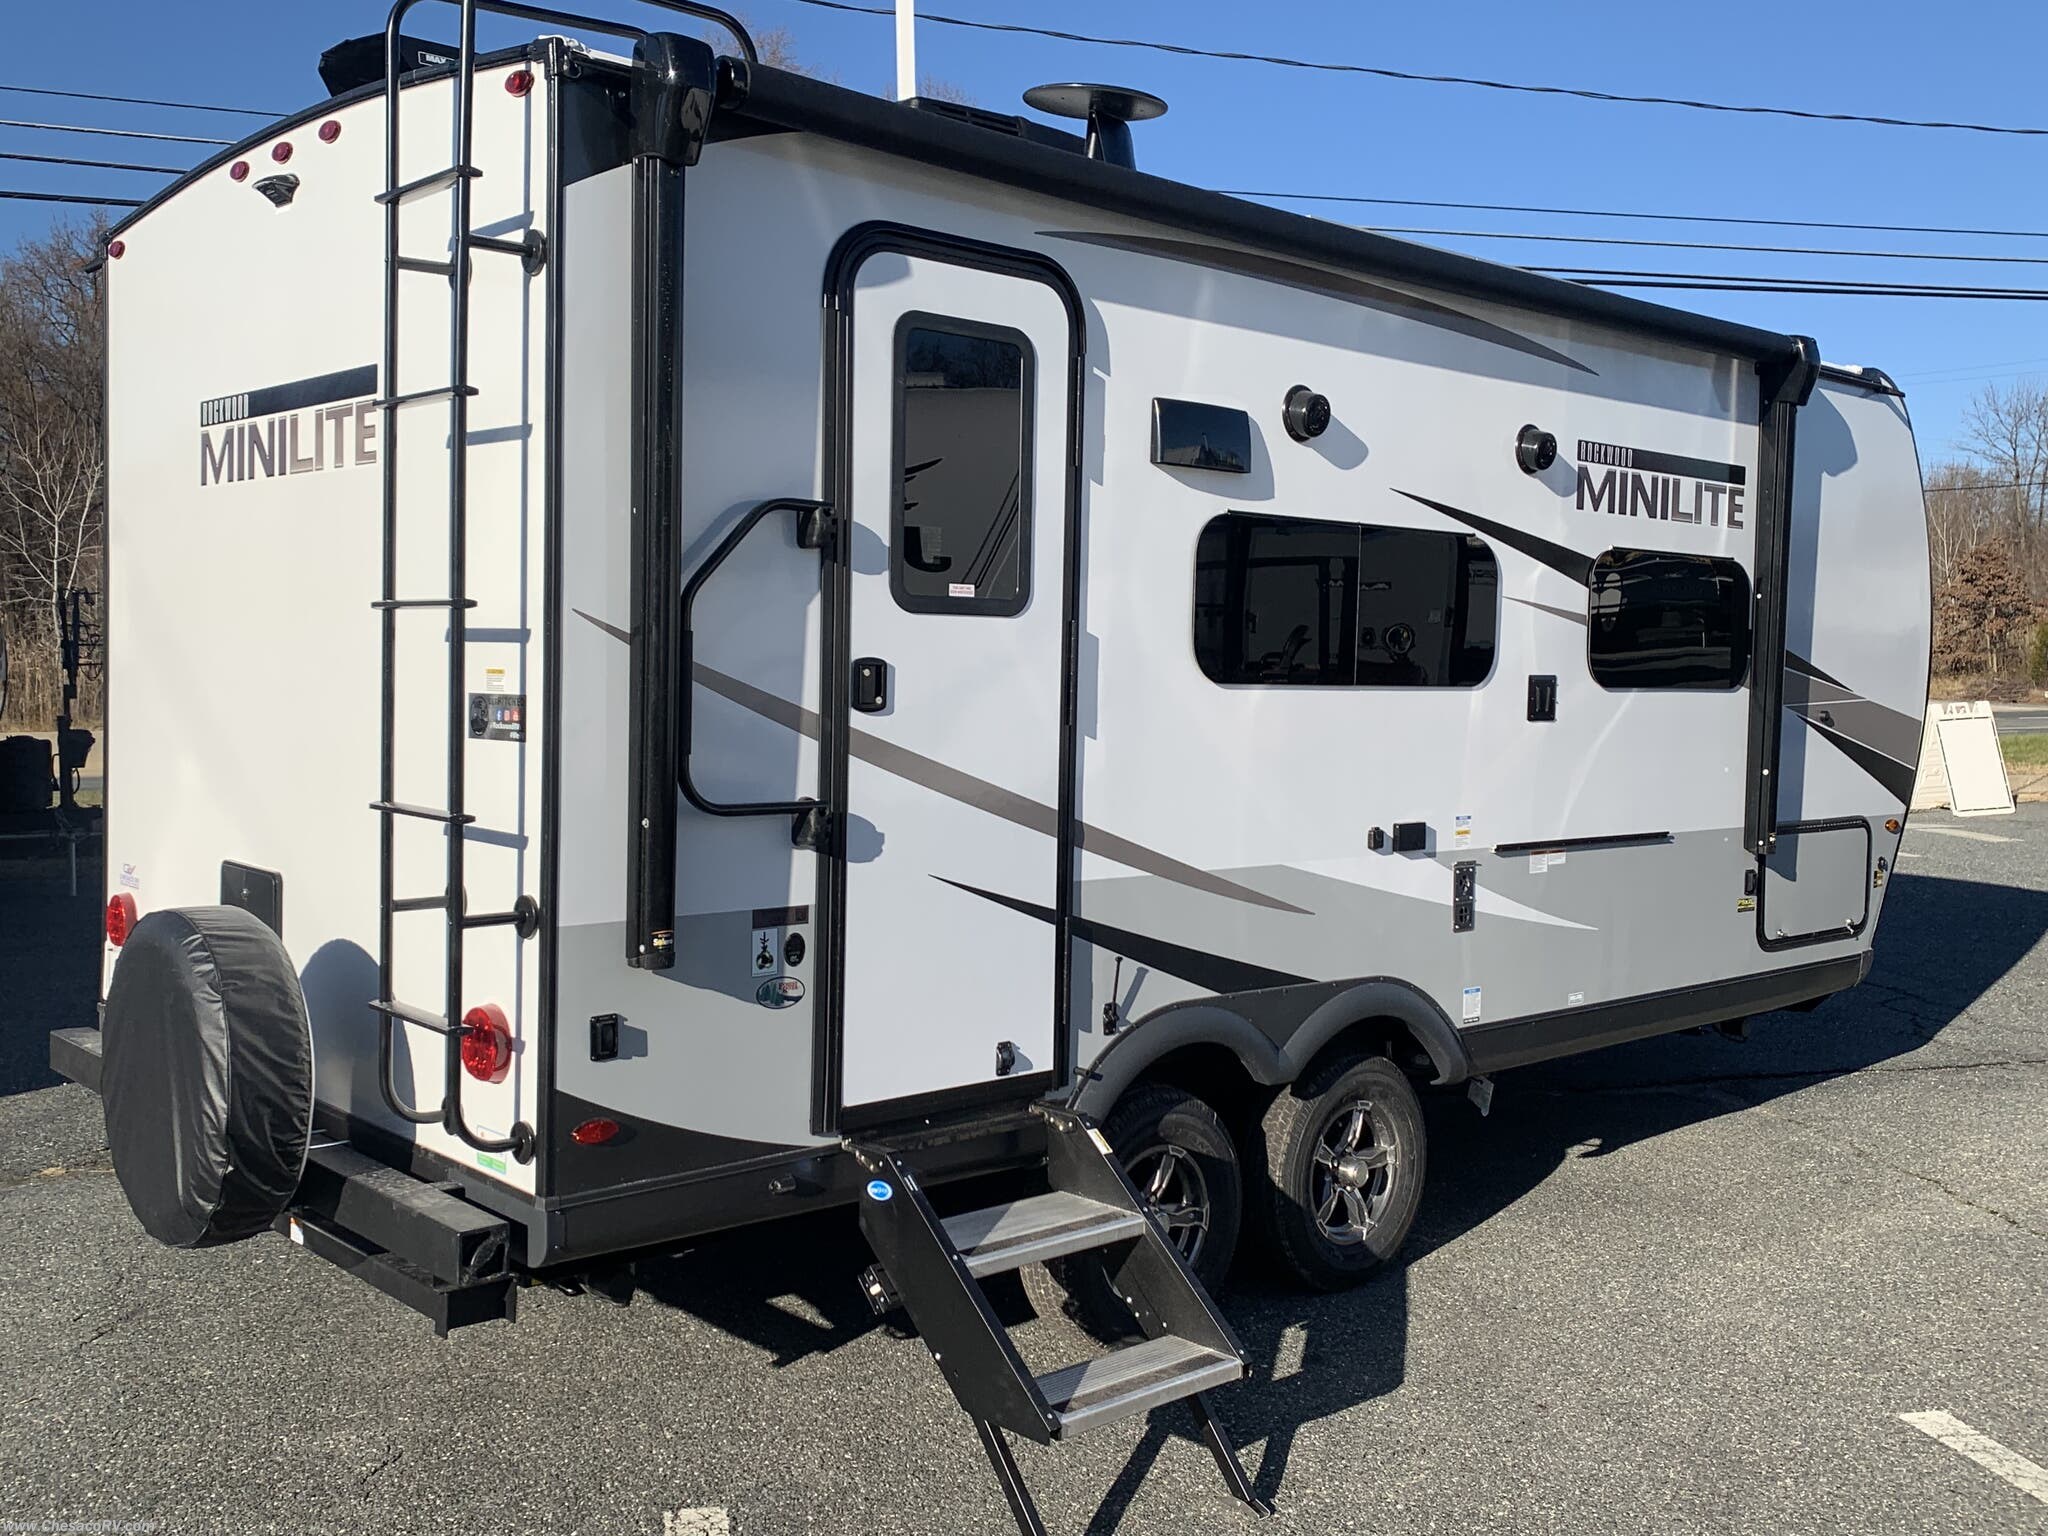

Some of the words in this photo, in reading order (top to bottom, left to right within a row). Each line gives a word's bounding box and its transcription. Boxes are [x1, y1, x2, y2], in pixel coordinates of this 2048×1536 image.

[202, 394, 249, 426] ROCKWOOD
[201, 399, 377, 486] MINILITE
[1580, 441, 1633, 468] ROCKWOOD
[1576, 464, 1745, 529] MINILITE
